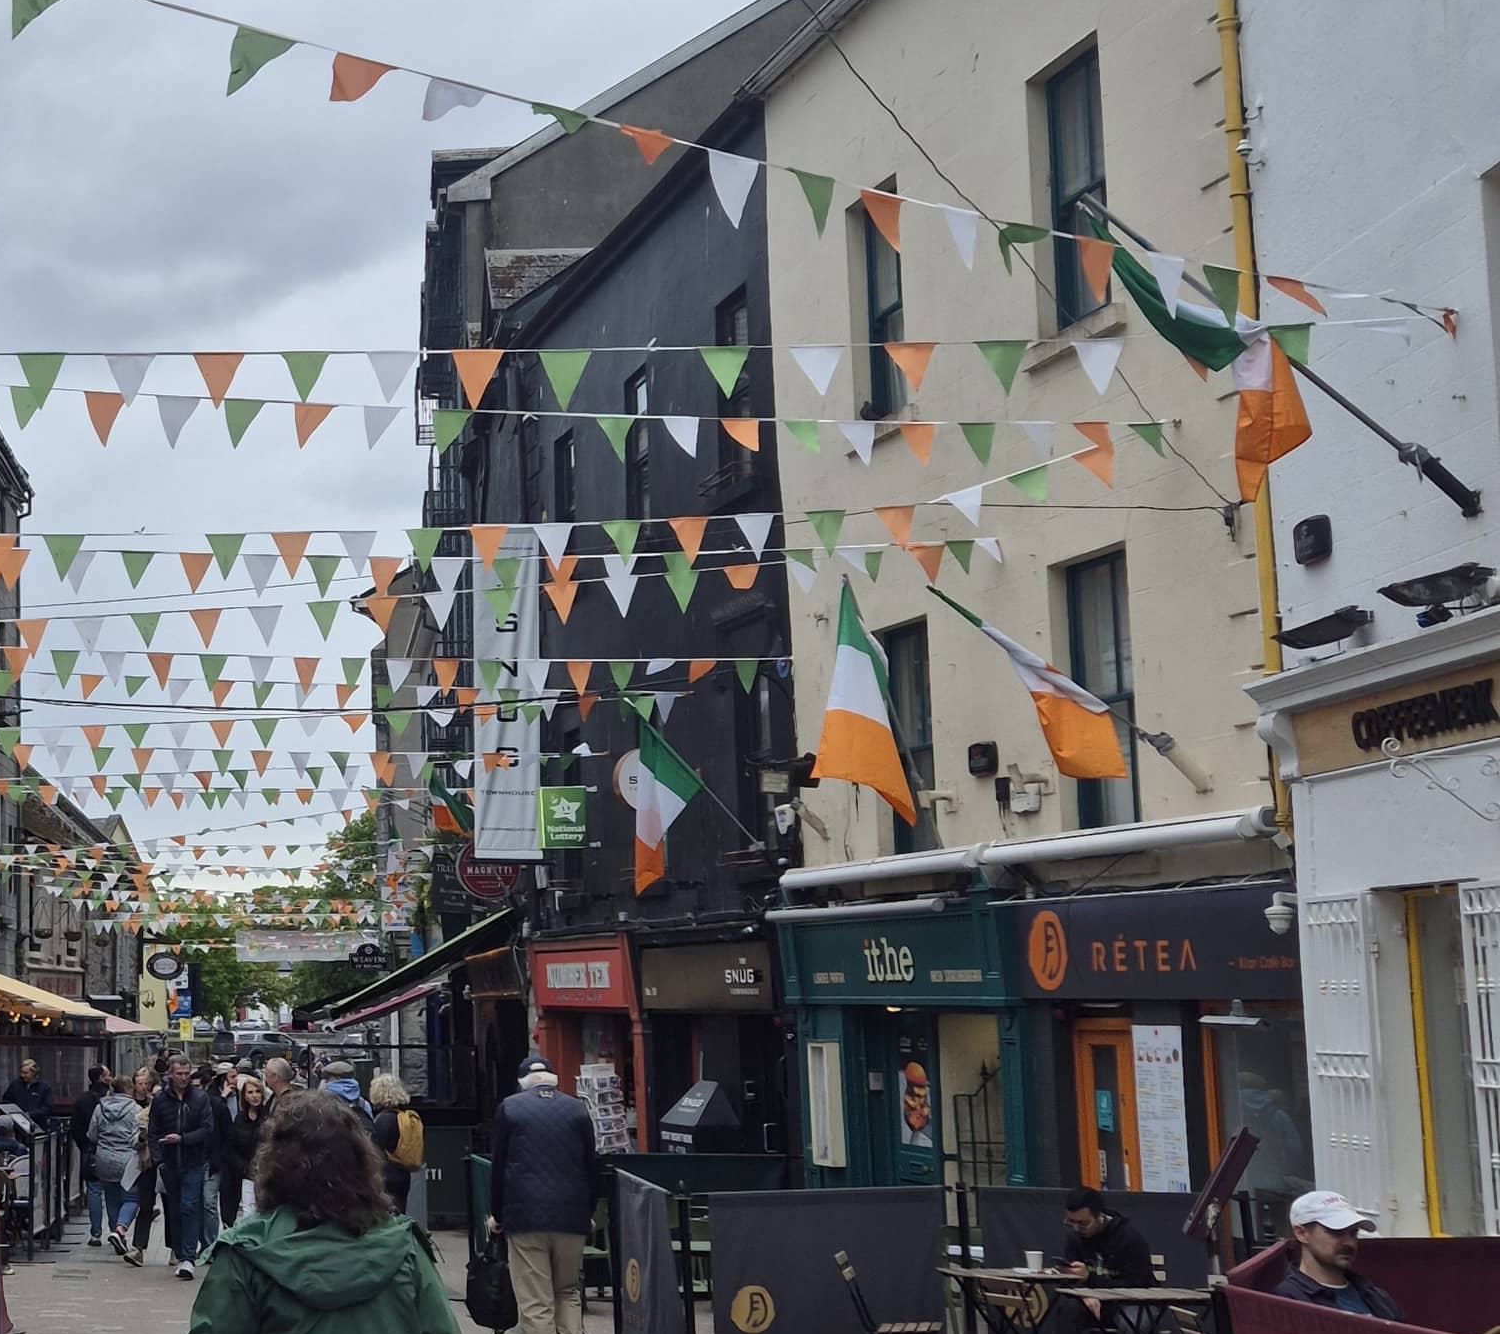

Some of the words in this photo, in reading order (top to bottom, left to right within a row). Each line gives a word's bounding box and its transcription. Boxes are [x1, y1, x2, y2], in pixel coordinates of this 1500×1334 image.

[546, 824, 587, 834] National
[550, 832, 585, 843] Lottery
[862, 936, 916, 983] ithe
[724, 968, 755, 984] SNUG
